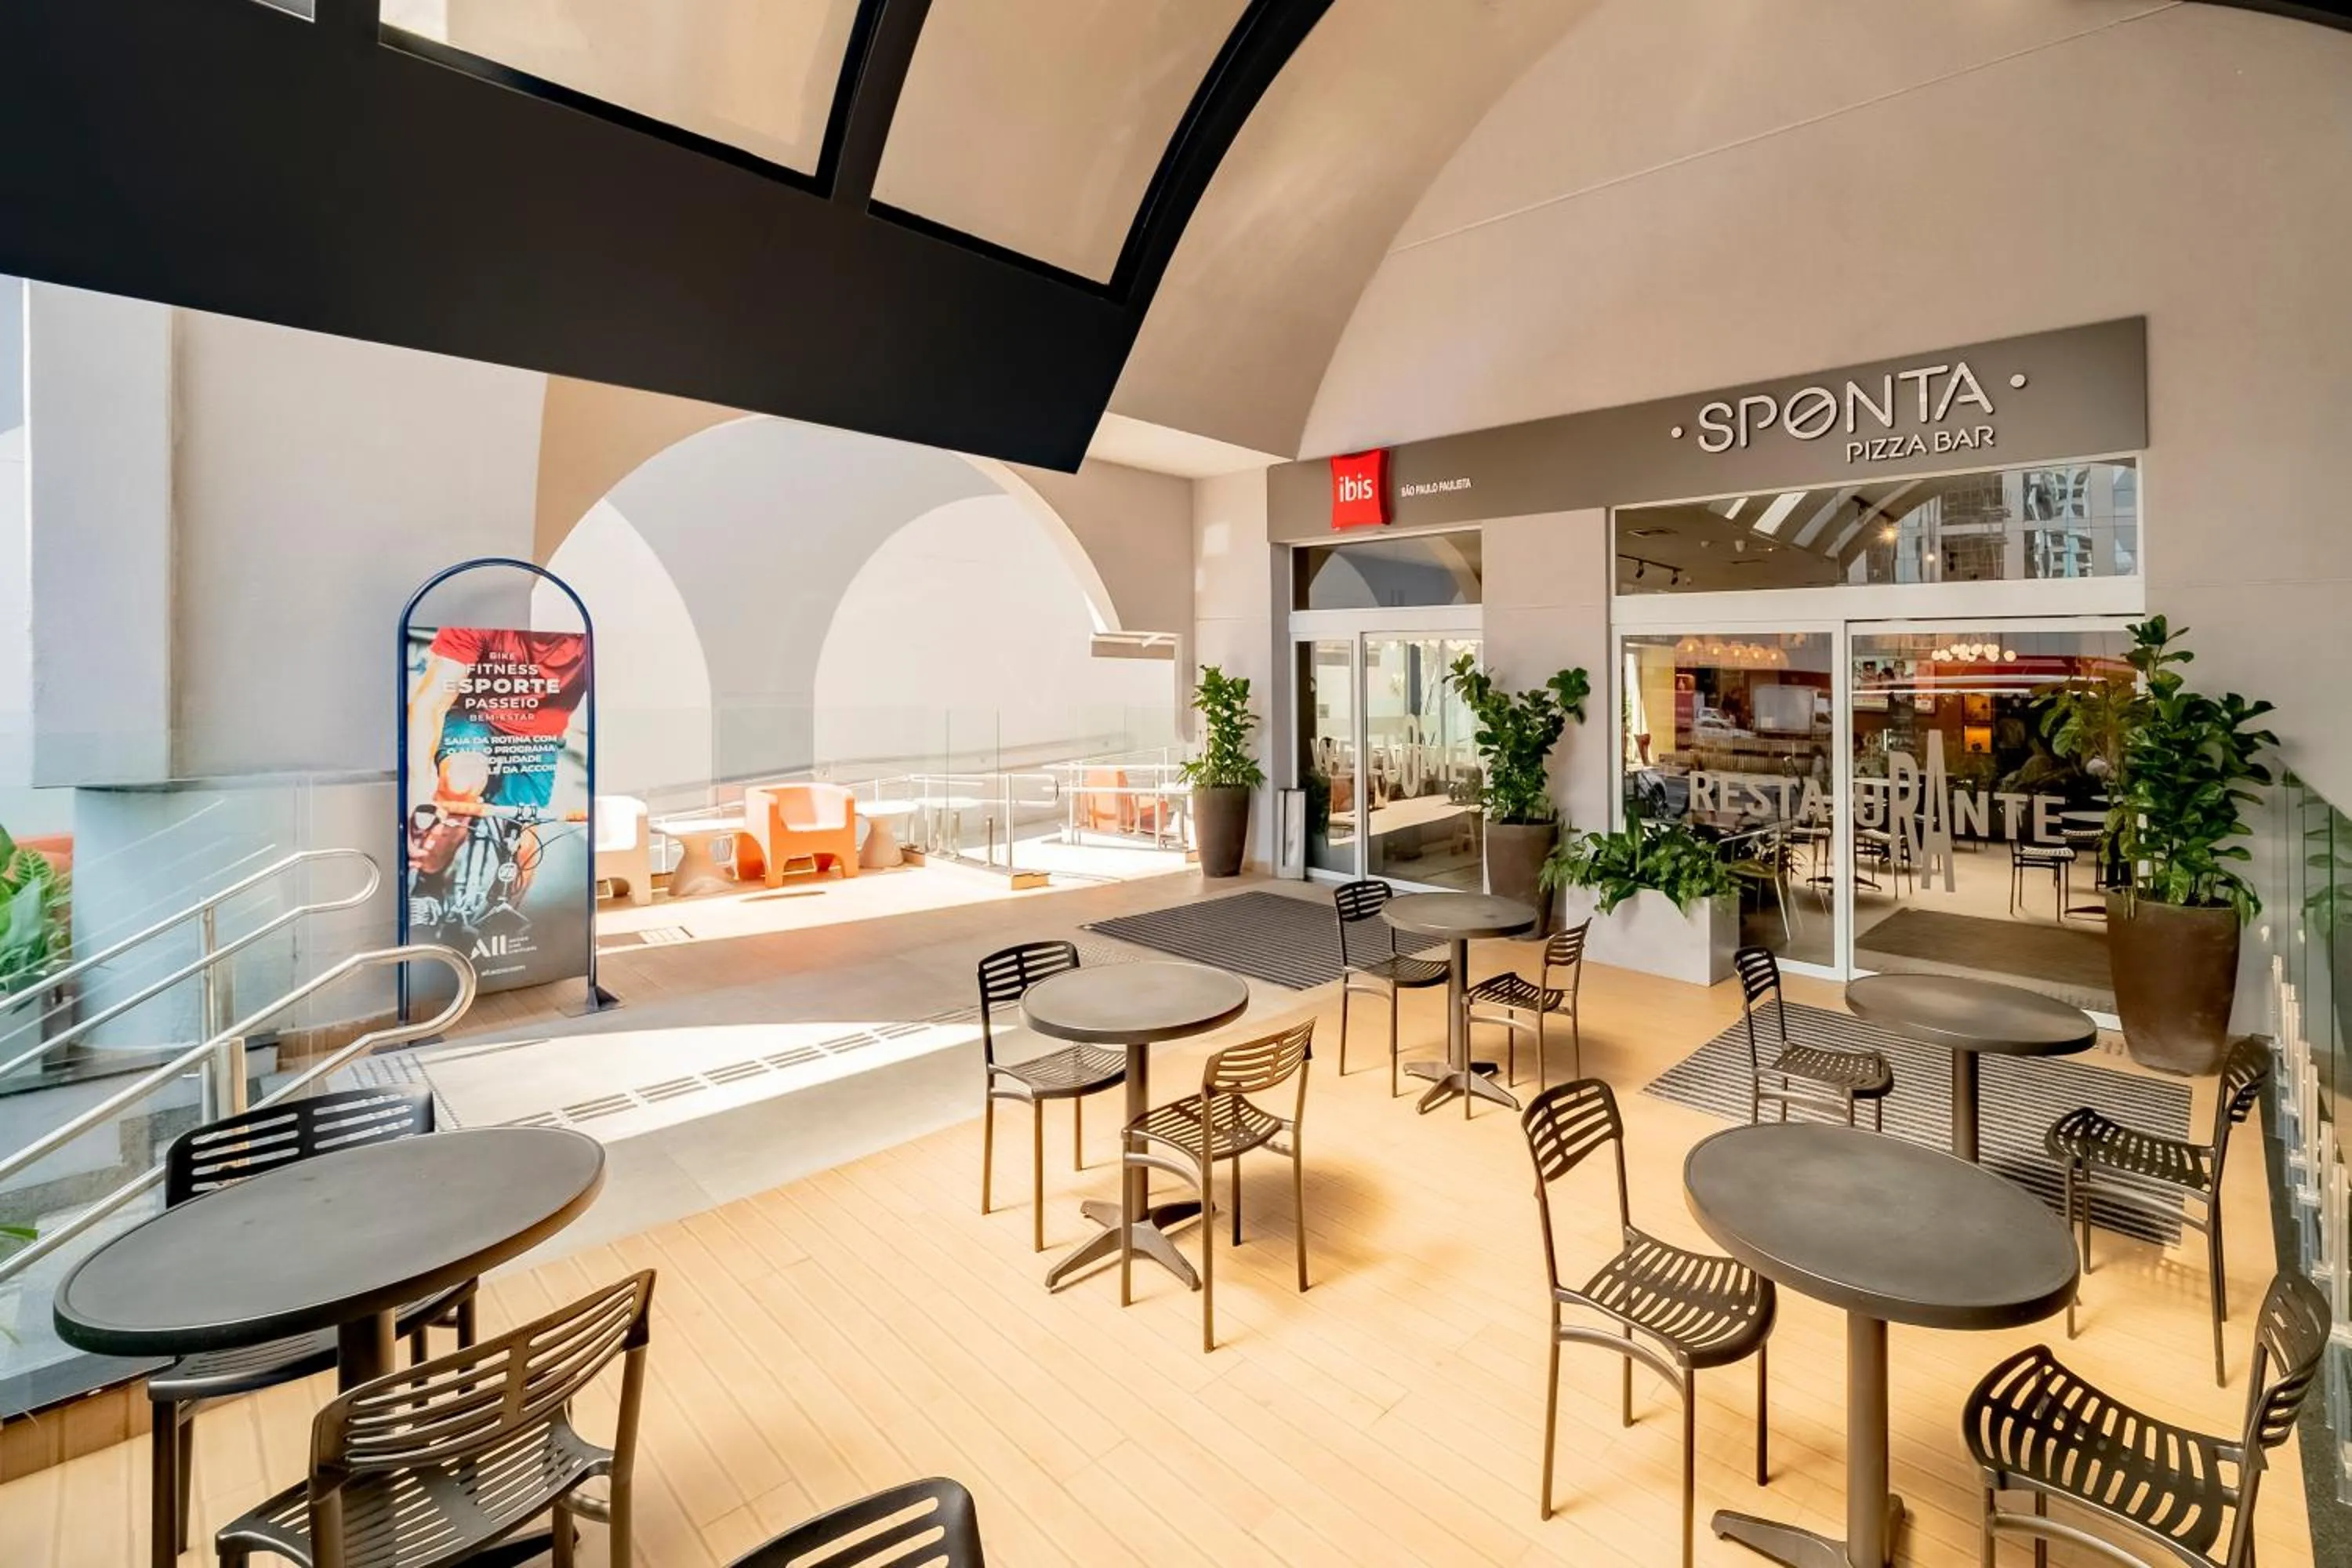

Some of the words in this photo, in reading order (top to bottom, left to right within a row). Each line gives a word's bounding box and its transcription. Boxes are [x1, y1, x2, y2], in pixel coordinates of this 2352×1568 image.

[1846, 434, 1928, 464] PIZZA
[1933, 425, 1996, 454] BAR
[1339, 474, 1373, 503] ibis
[1401, 483, 1415, 498] SÃO
[1416, 481, 1438, 495] PAULO
[489, 652, 515, 660] BIKE
[466, 663, 539, 675] FITNESS
[442, 678, 561, 694] ESPORTE
[465, 697, 539, 710] PASSEIO
[444, 736, 470, 746] SAIA
[473, 735, 489, 744] DA
[491, 735, 531, 744] ROTINA
[532, 734, 557, 742] COM
[495, 745, 557, 754] PROGRAMA
[503, 766, 519, 775] DA
[1690, 729, 2067, 893] RESTAURANTE
